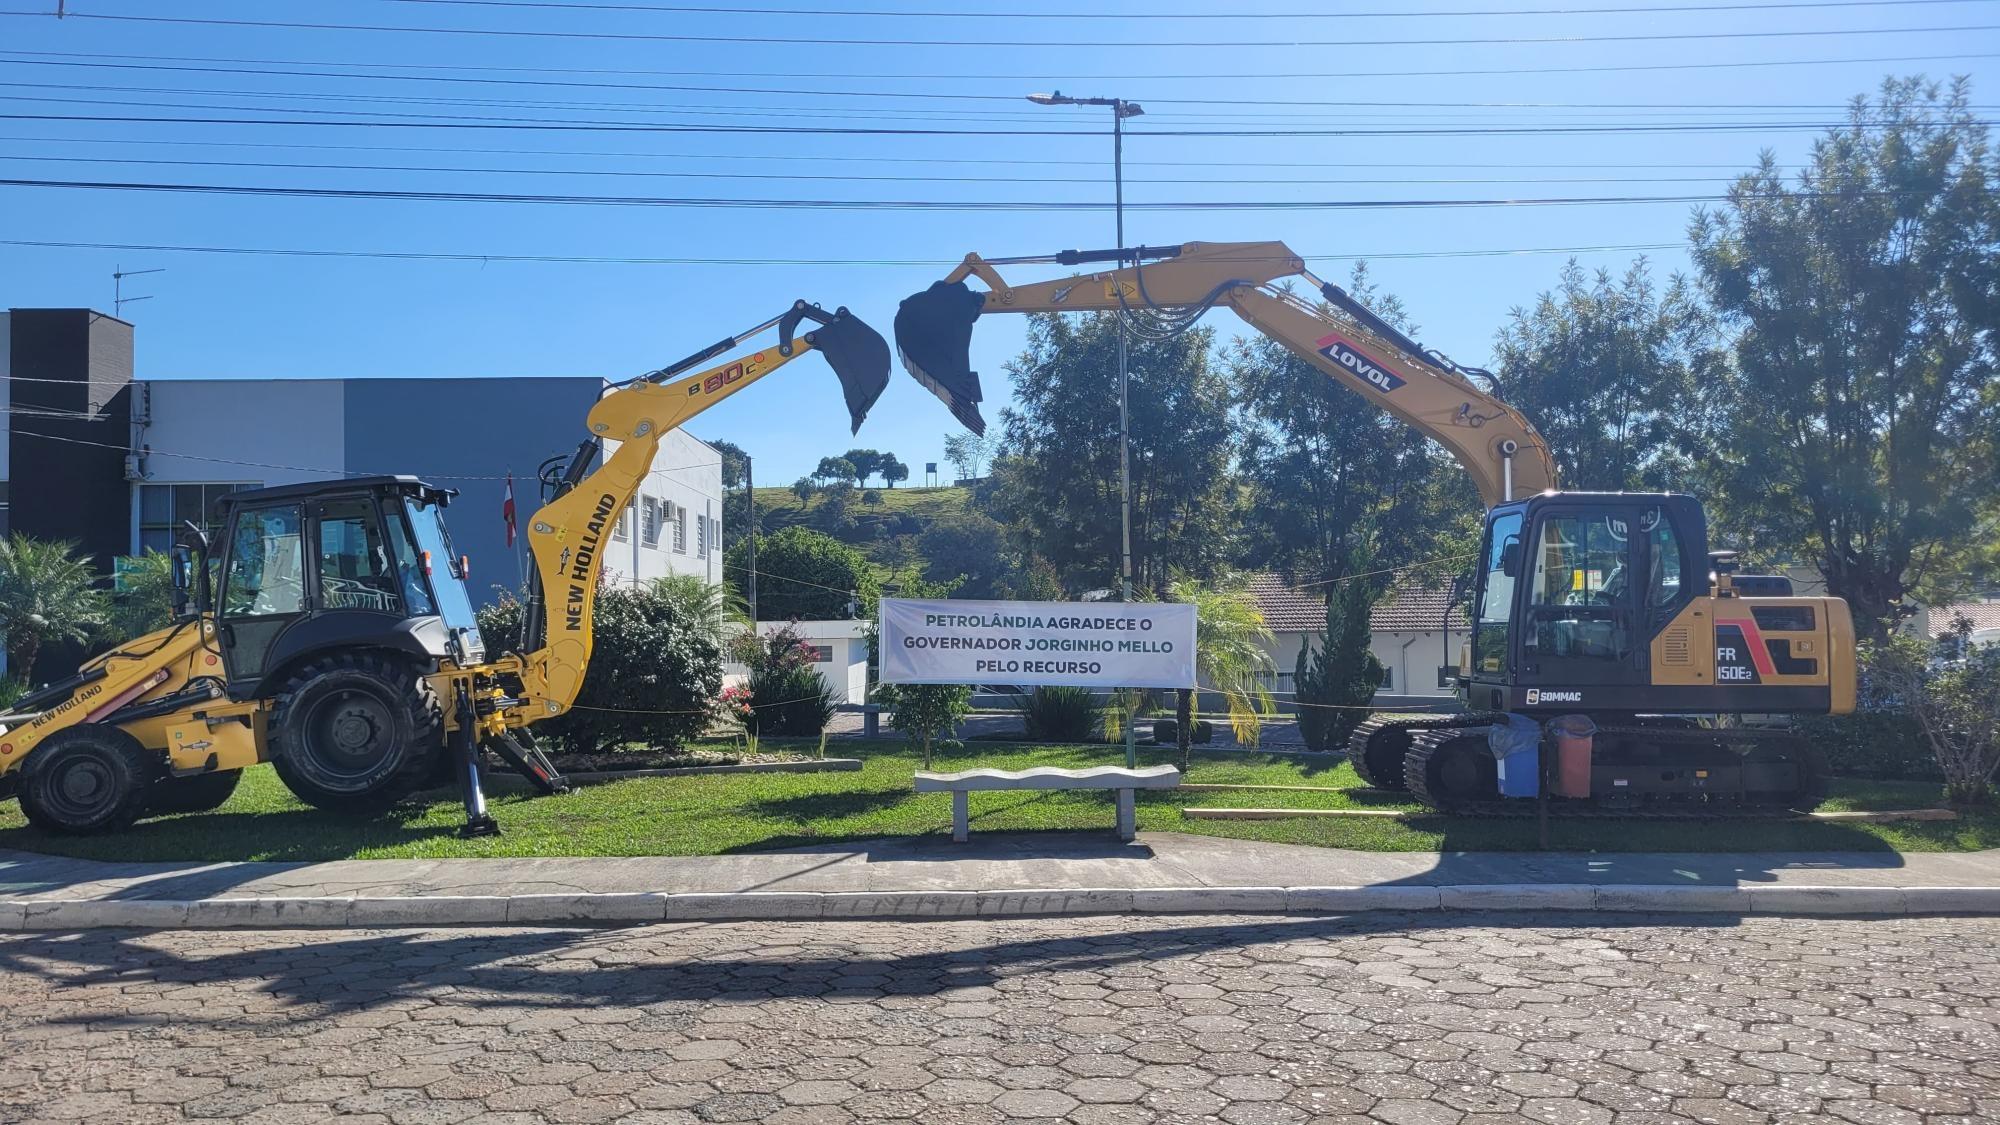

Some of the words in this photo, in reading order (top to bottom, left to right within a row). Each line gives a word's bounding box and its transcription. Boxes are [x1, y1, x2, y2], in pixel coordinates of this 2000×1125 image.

[1329, 344, 1391, 391] LOVOL
[571, 493, 616, 581] HOLLAND
[566, 583, 585, 631] NEW
[926, 612, 1044, 629] PETROLÂNDIA
[1046, 616, 1137, 631] AGRADECE
[1140, 618, 1153, 631] O
[903, 636, 1022, 651] GOVERNADOR
[1025, 638, 1114, 653] JORGINHO
[1118, 640, 1174, 654] MELLO
[1717, 647, 1737, 661] FR
[976, 659, 1019, 673] PELO
[1023, 660, 1102, 675] RECURSO
[1540, 691, 1582, 702] SOMMAC
[31, 711, 56, 729] NEW
[56, 685, 103, 714] HOLLAND
